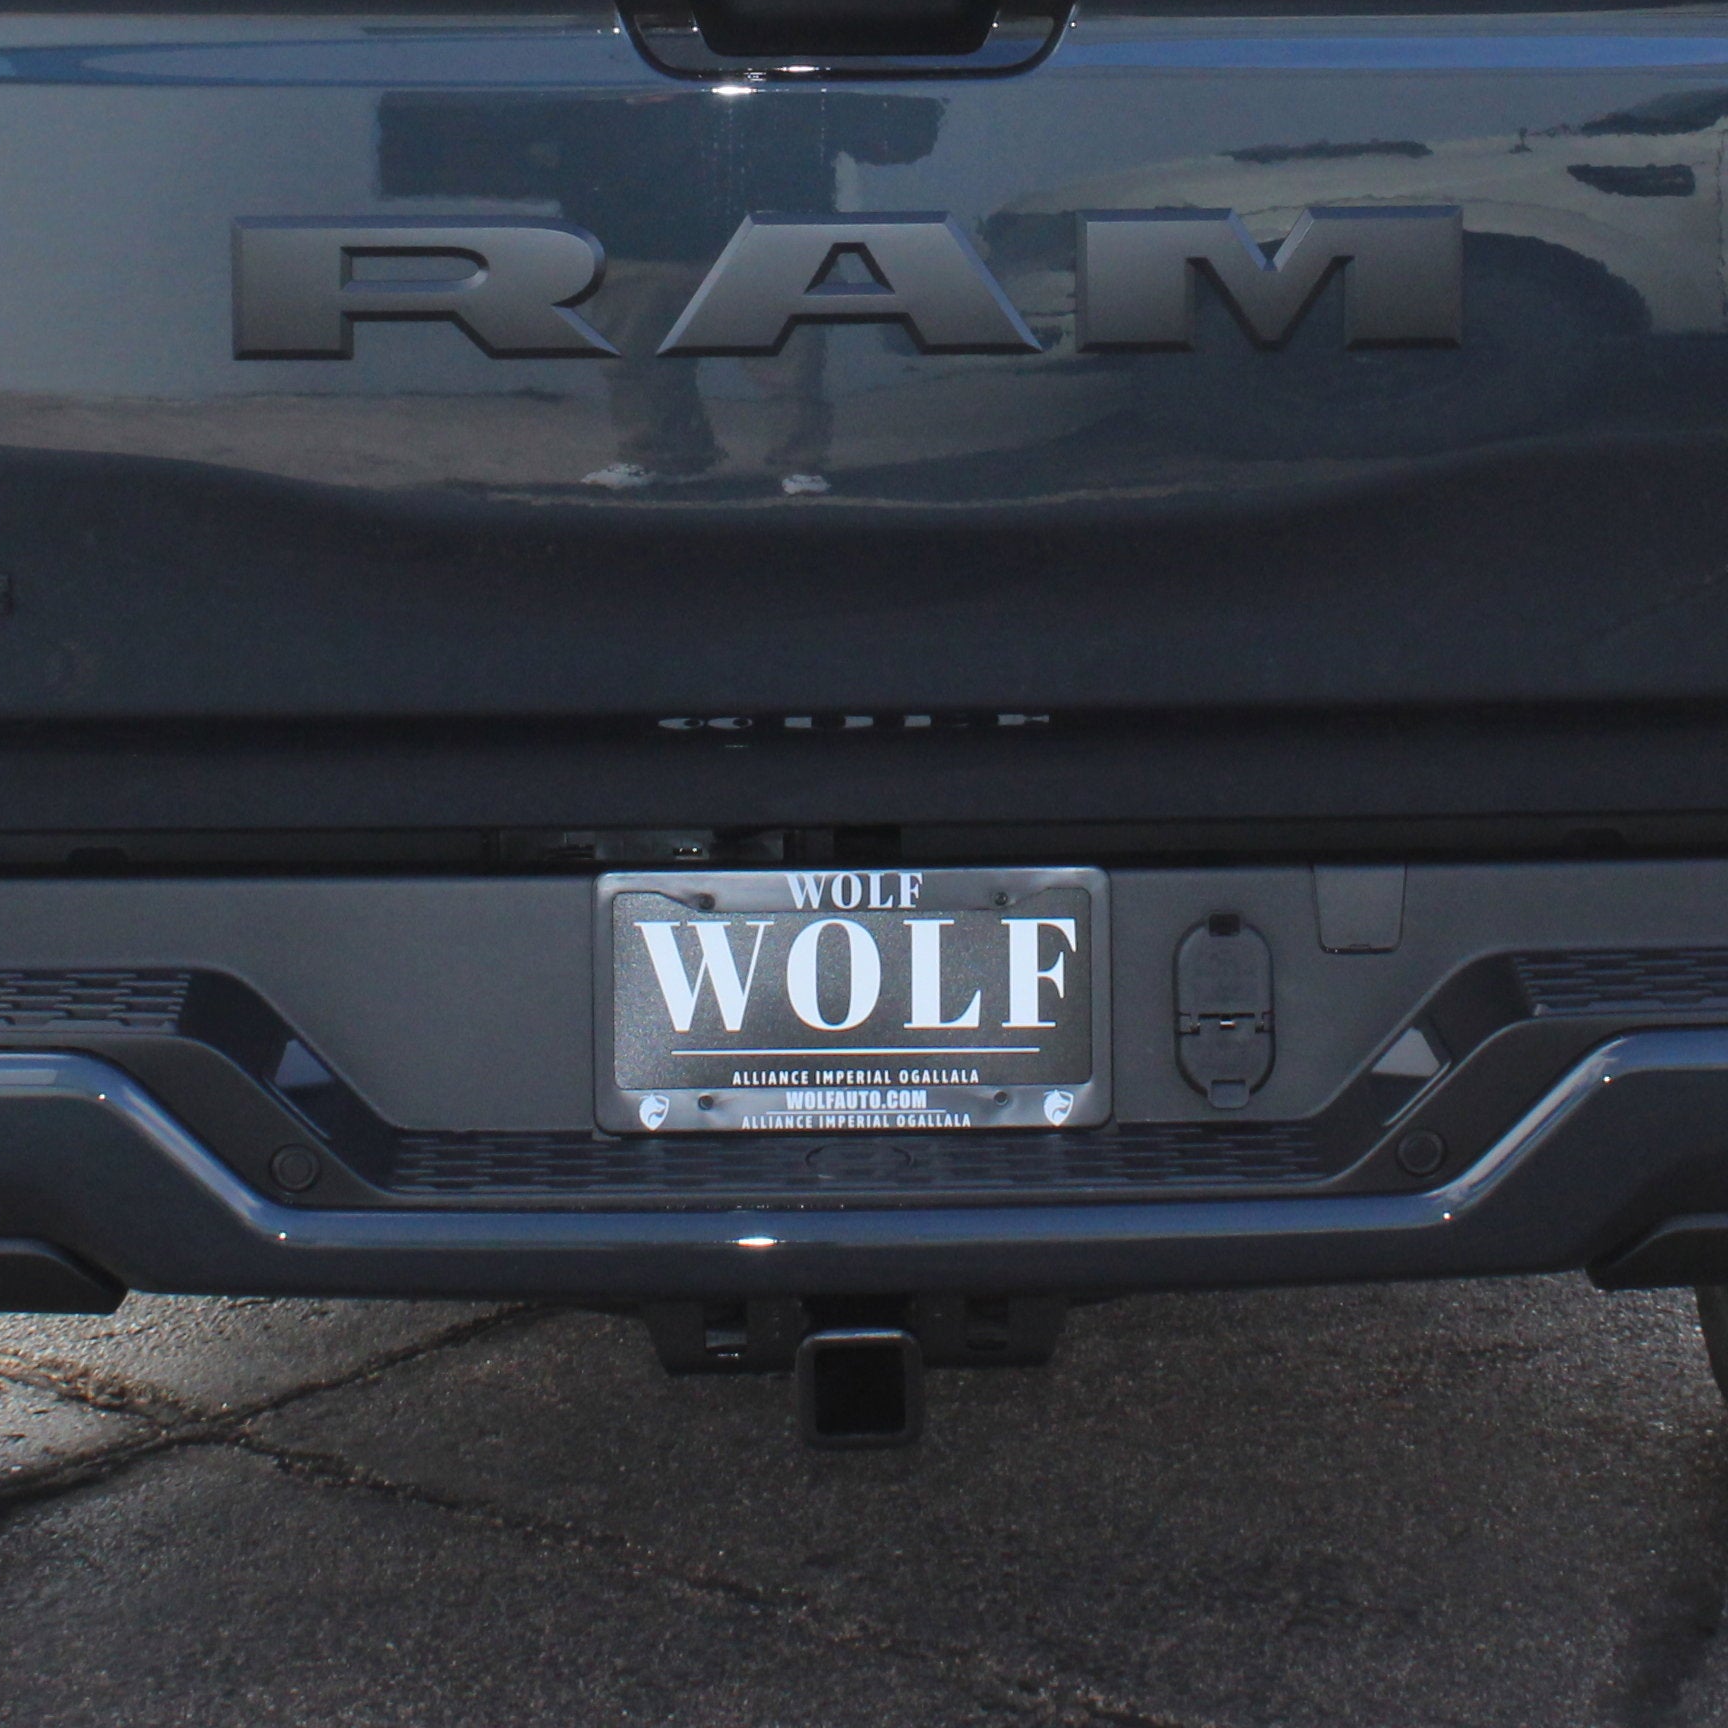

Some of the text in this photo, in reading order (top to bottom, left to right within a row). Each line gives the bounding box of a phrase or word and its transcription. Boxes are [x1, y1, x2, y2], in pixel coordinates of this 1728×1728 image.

[232, 205, 1462, 360] RAM
[785, 872, 923, 910] WOLF
[634, 918, 1078, 1032] WOLF
[732, 1069, 980, 1086] ALLIANCE IMPERIAL OGALLALA
[786, 1089, 927, 1110] WOLFAUTO.COM
[741, 1113, 972, 1130] ALLIANCE IMPERIAL OGALLALA
